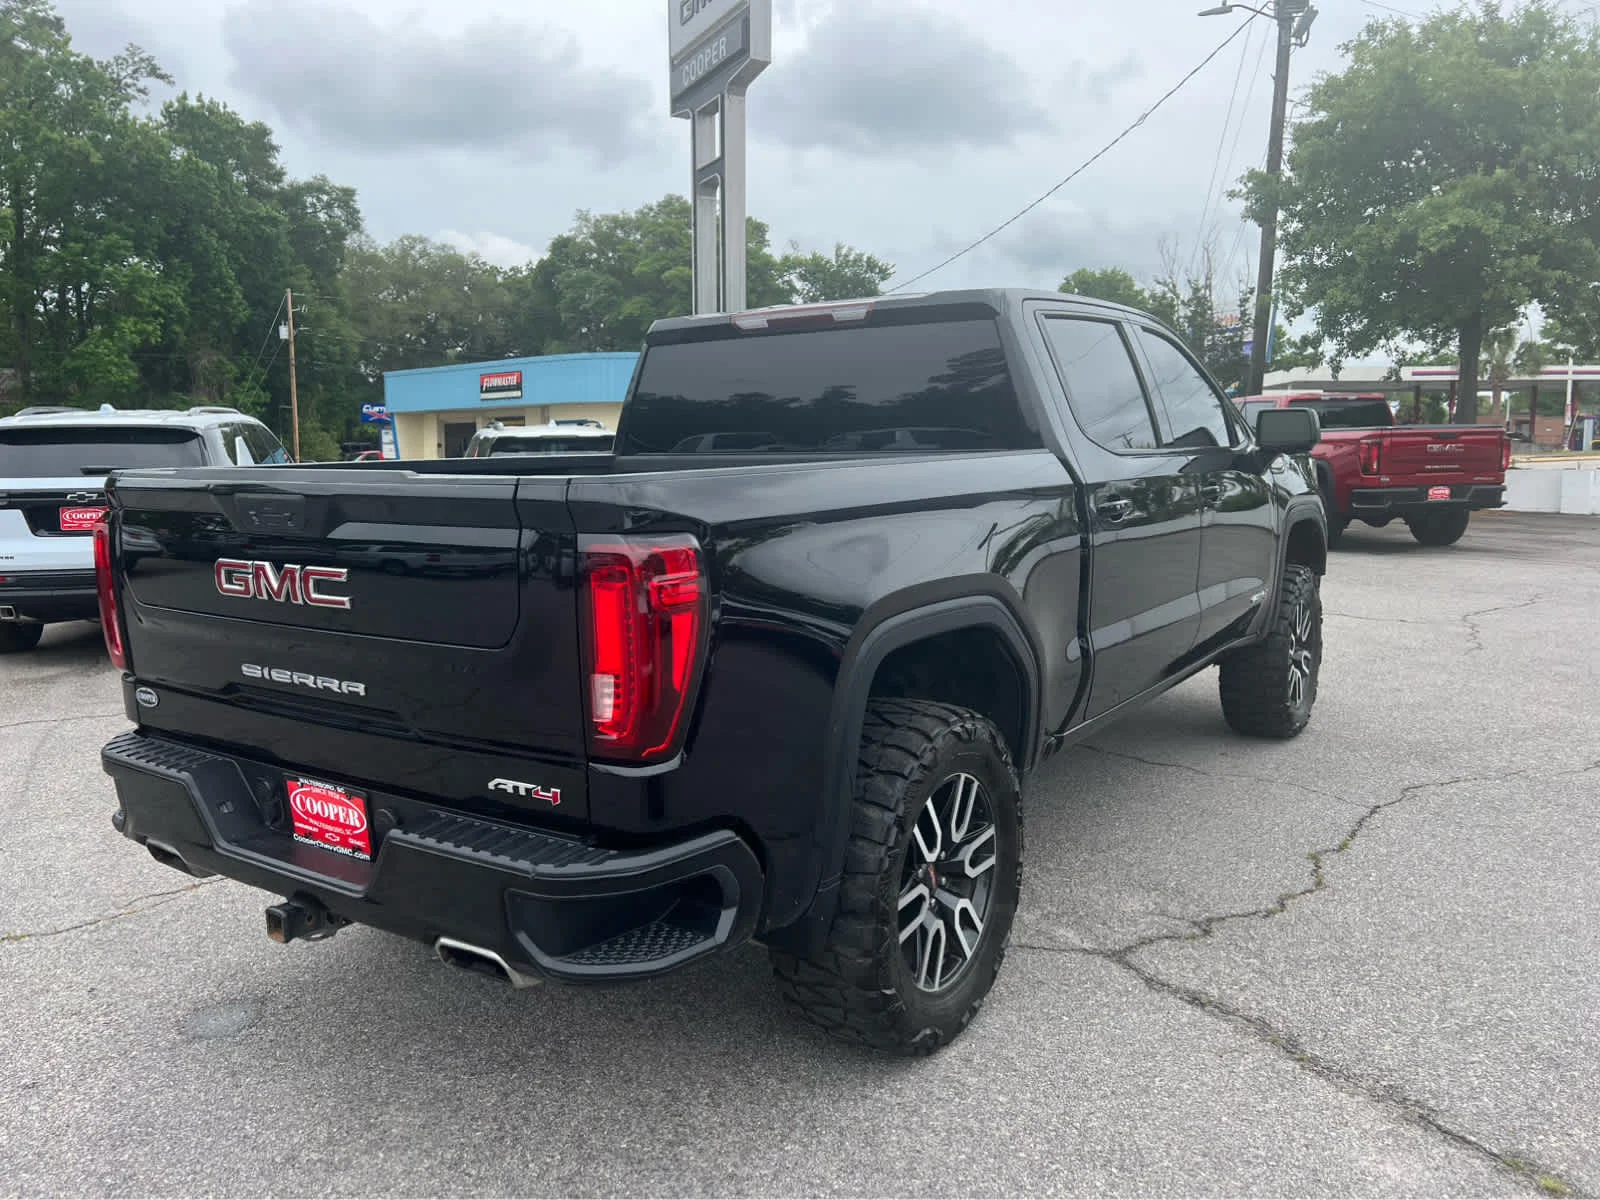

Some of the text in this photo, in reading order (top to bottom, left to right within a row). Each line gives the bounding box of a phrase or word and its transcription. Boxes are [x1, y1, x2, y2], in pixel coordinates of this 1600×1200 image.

[682, 37, 727, 86] COOPER
[65, 511, 102, 520] COOPE
[214, 558, 351, 609] GMC
[241, 663, 366, 696] SIERRA
[487, 778, 561, 806] AT4
[295, 794, 362, 828] COOPER
